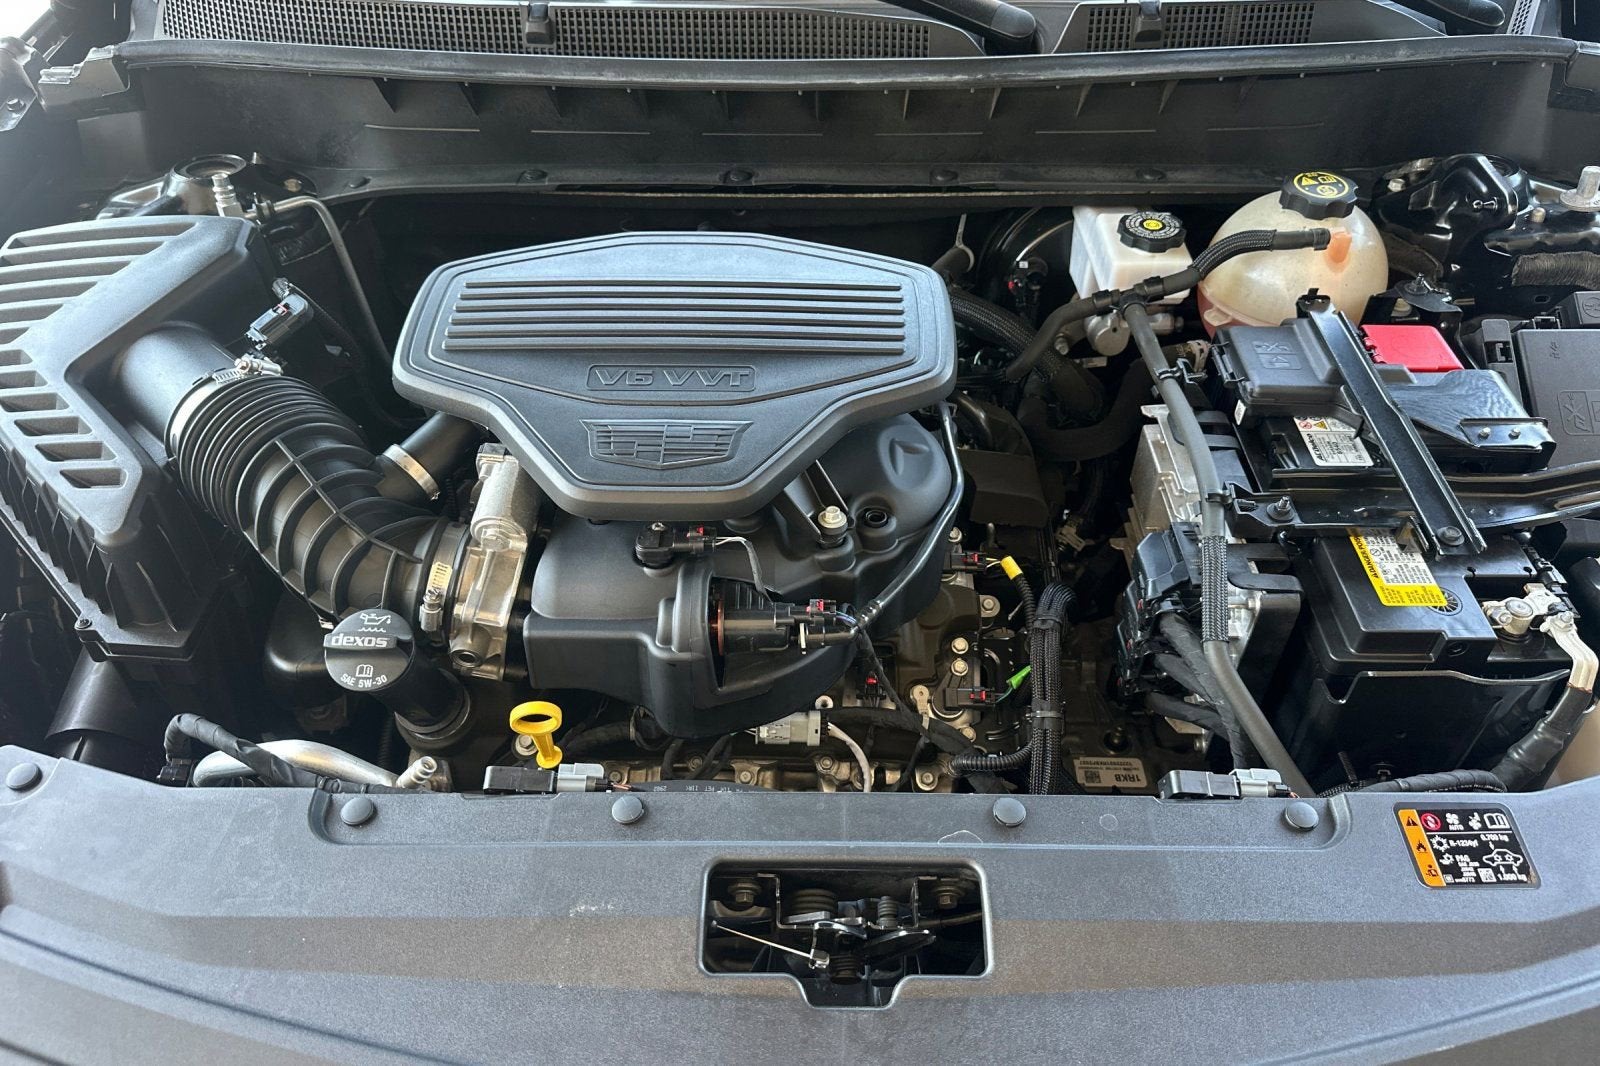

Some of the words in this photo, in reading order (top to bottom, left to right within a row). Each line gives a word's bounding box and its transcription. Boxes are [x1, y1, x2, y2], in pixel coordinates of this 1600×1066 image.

[595, 369, 653, 386] V6
[663, 369, 750, 387] VVT
[1360, 550, 1376, 573] DANGER
[331, 633, 388, 648] dexos
[340, 673, 357, 686] SAE
[358, 674, 388, 688] 5W-30
